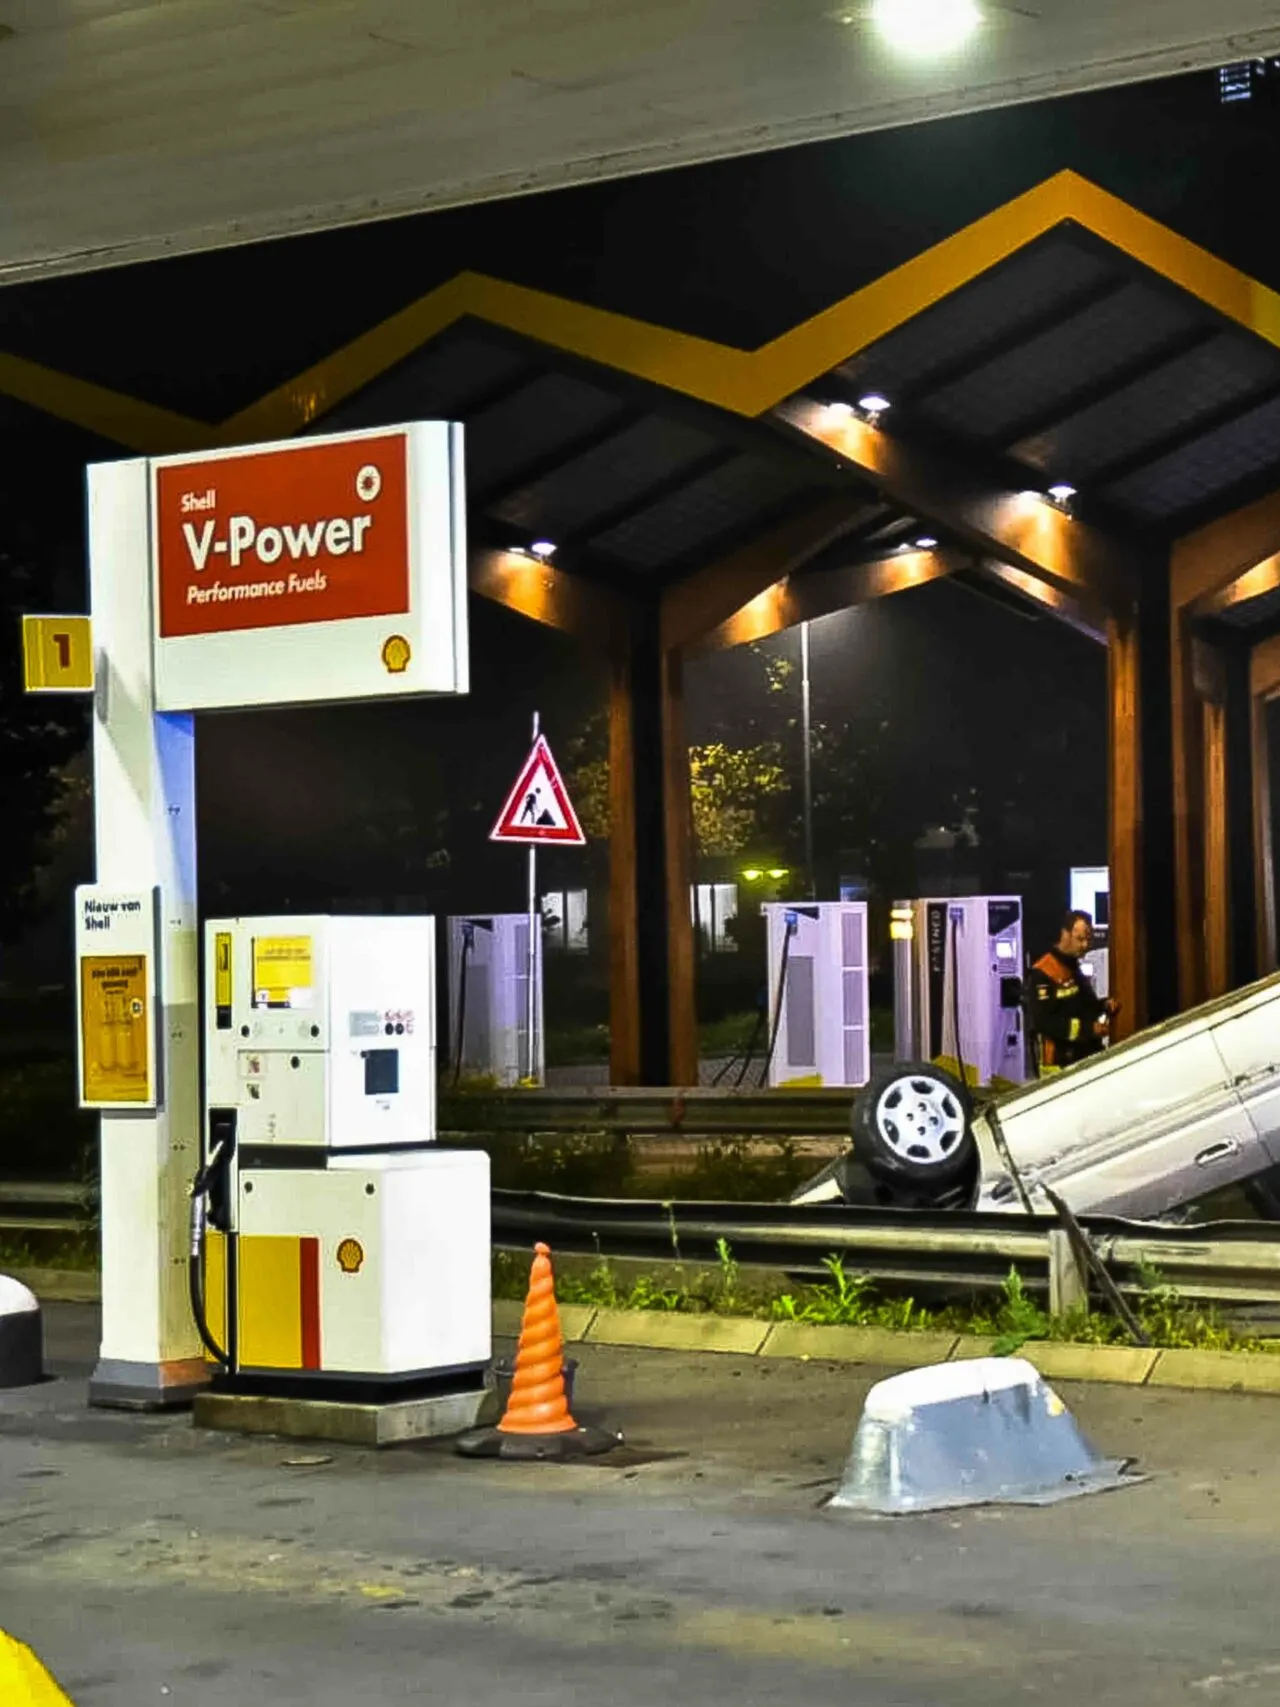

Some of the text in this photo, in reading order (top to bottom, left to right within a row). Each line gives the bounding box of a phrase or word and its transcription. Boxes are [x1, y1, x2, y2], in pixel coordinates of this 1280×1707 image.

[180, 489, 216, 512] Shell
[181, 514, 372, 571] V-Power
[187, 568, 327, 605] Performance Fuels
[53, 633, 70, 668] 1
[84, 898, 141, 914] Nieuw van
[84, 914, 110, 931] Shell
